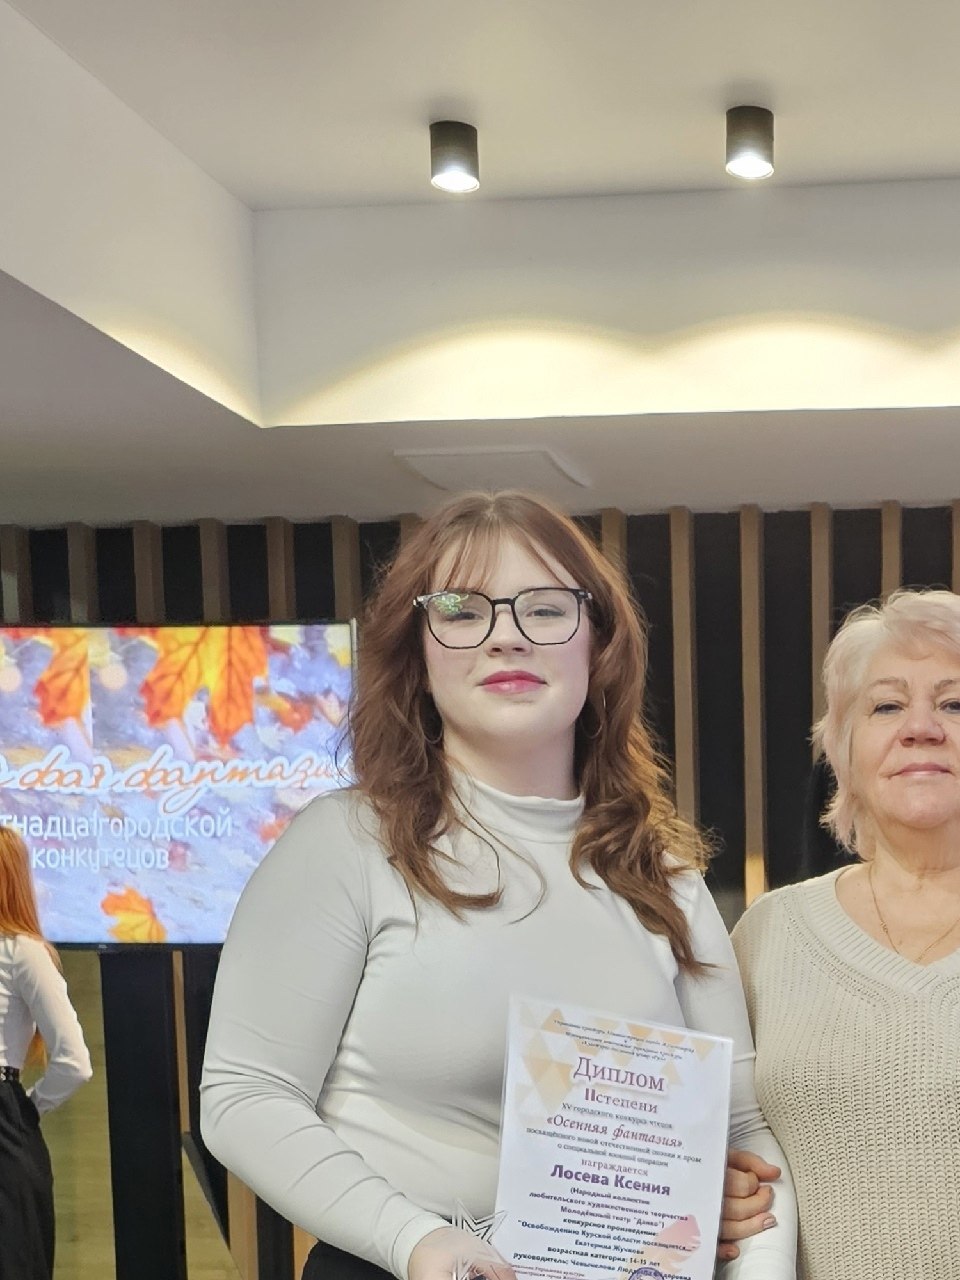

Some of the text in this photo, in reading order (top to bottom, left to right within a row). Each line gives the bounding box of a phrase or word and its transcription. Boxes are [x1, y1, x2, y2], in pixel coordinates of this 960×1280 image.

[573, 1056, 665, 1092] Диплом
[546, 1114, 608, 1135] «Осенняя
[550, 1164, 671, 1196] Лосева Ксения
[581, 1158, 648, 1176] награждается
